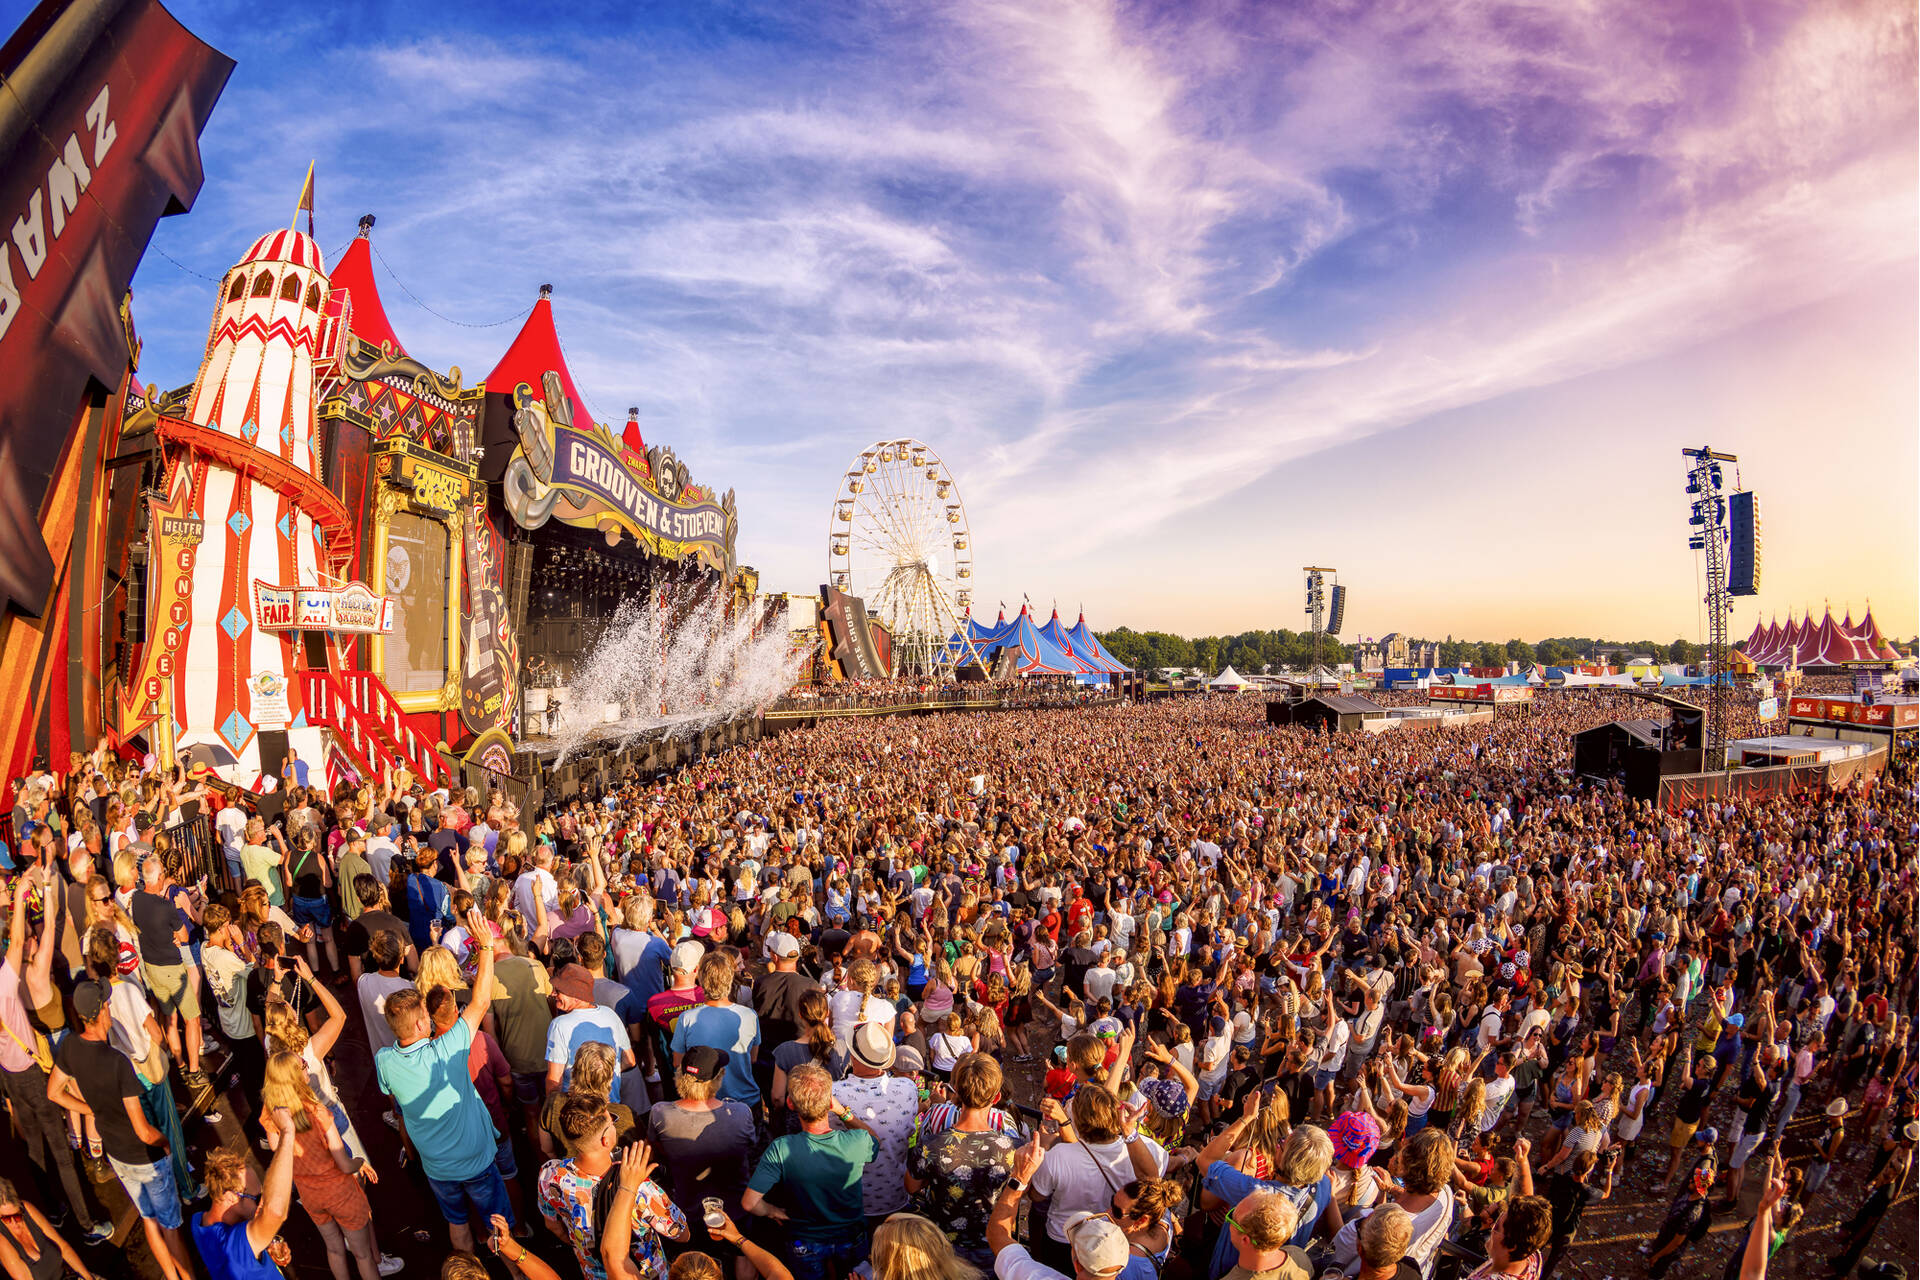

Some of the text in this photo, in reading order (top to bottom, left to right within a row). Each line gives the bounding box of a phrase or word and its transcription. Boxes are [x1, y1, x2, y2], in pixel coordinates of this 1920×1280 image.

[413, 465, 462, 501] ZWARTE
[570, 441, 723, 538] GROOVEN & STOEVEN!
[416, 485, 456, 513] CROSS
[164, 519, 202, 536] HELTER
[144, 553, 189, 696] ENTREE
[263, 604, 291, 624] FAIR
[303, 615, 327, 623] ALL
[844, 605, 858, 642] CROSS
[664, 1004, 692, 1014] ZWARTE
